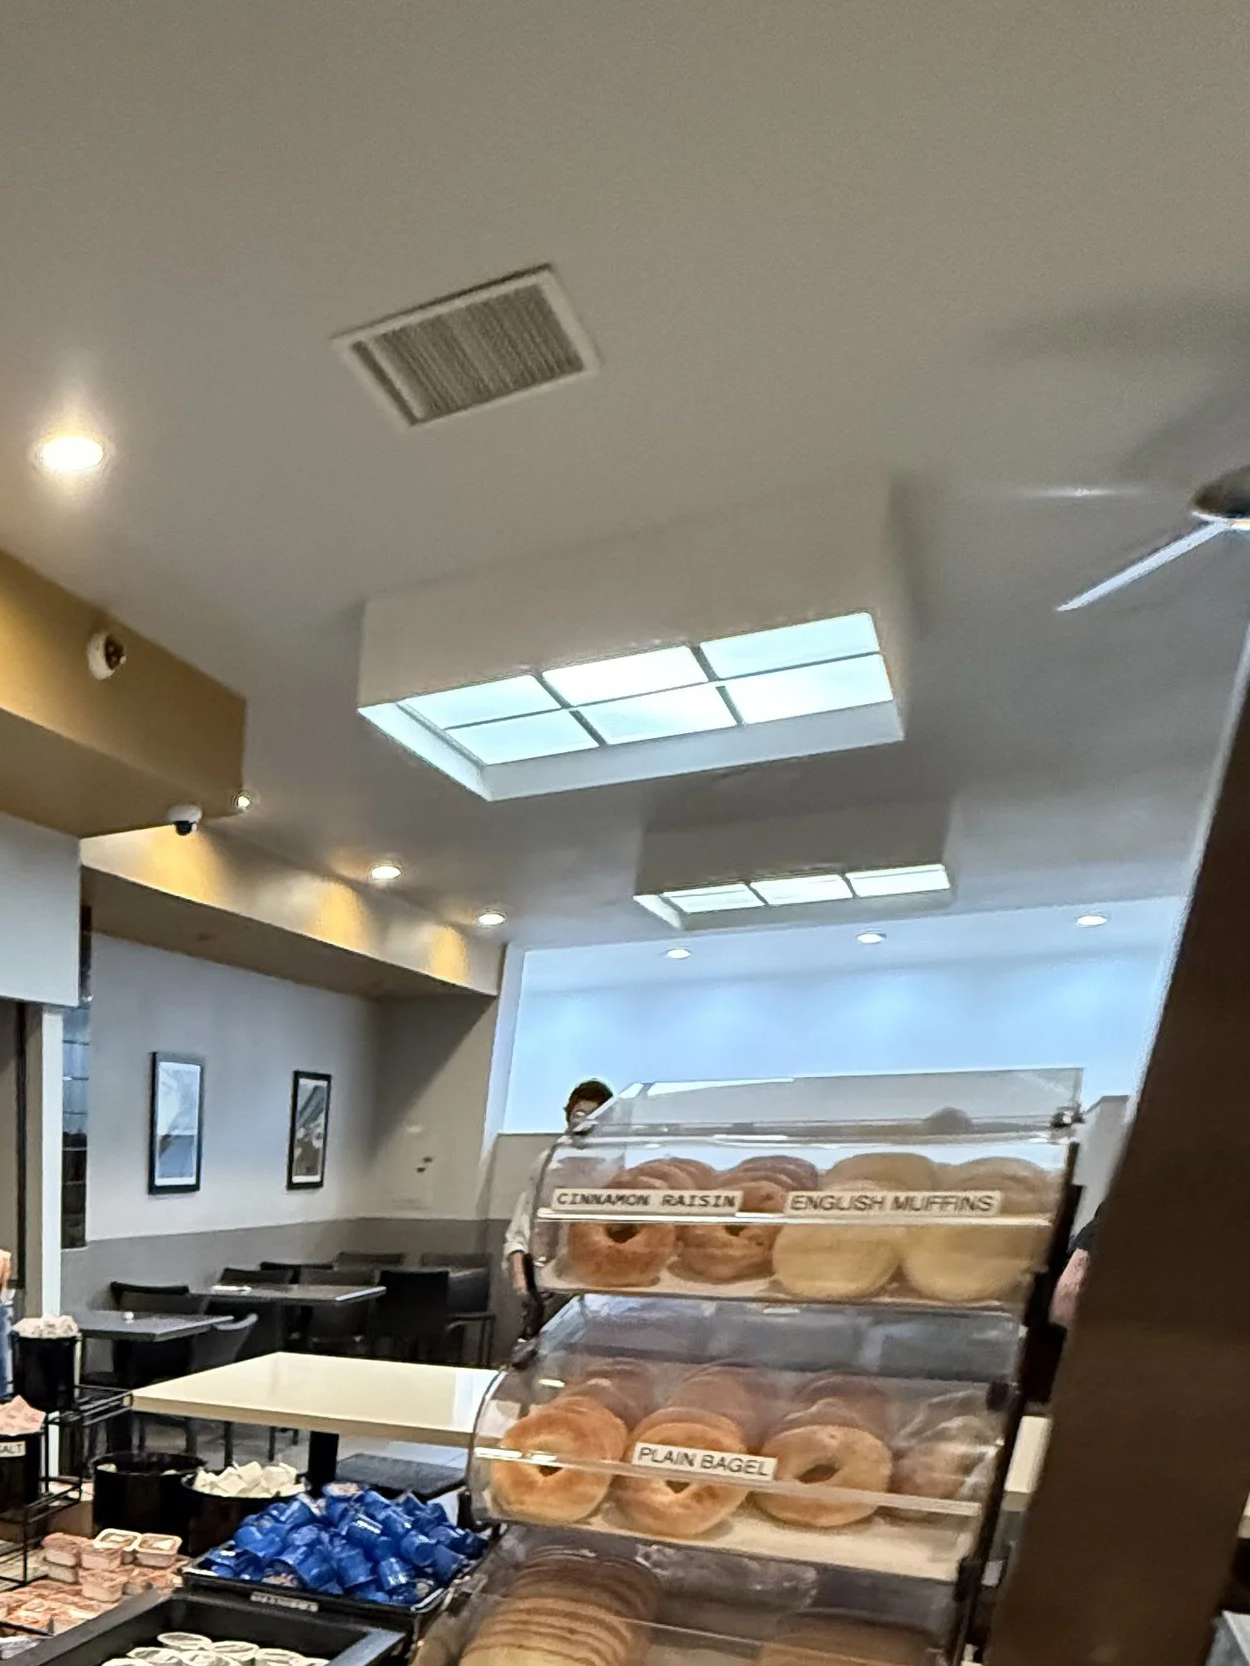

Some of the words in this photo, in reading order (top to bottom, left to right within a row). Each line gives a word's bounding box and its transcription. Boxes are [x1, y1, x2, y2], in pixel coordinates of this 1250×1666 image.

[556, 1192, 650, 1207] CINNAMON
[661, 1193, 737, 1208] RAISIN
[790, 1194, 884, 1212] ENGLISH
[892, 1194, 995, 1212] MUFFINS
[637, 1446, 697, 1467] PLAIN
[700, 1453, 769, 1477] BAGEL
